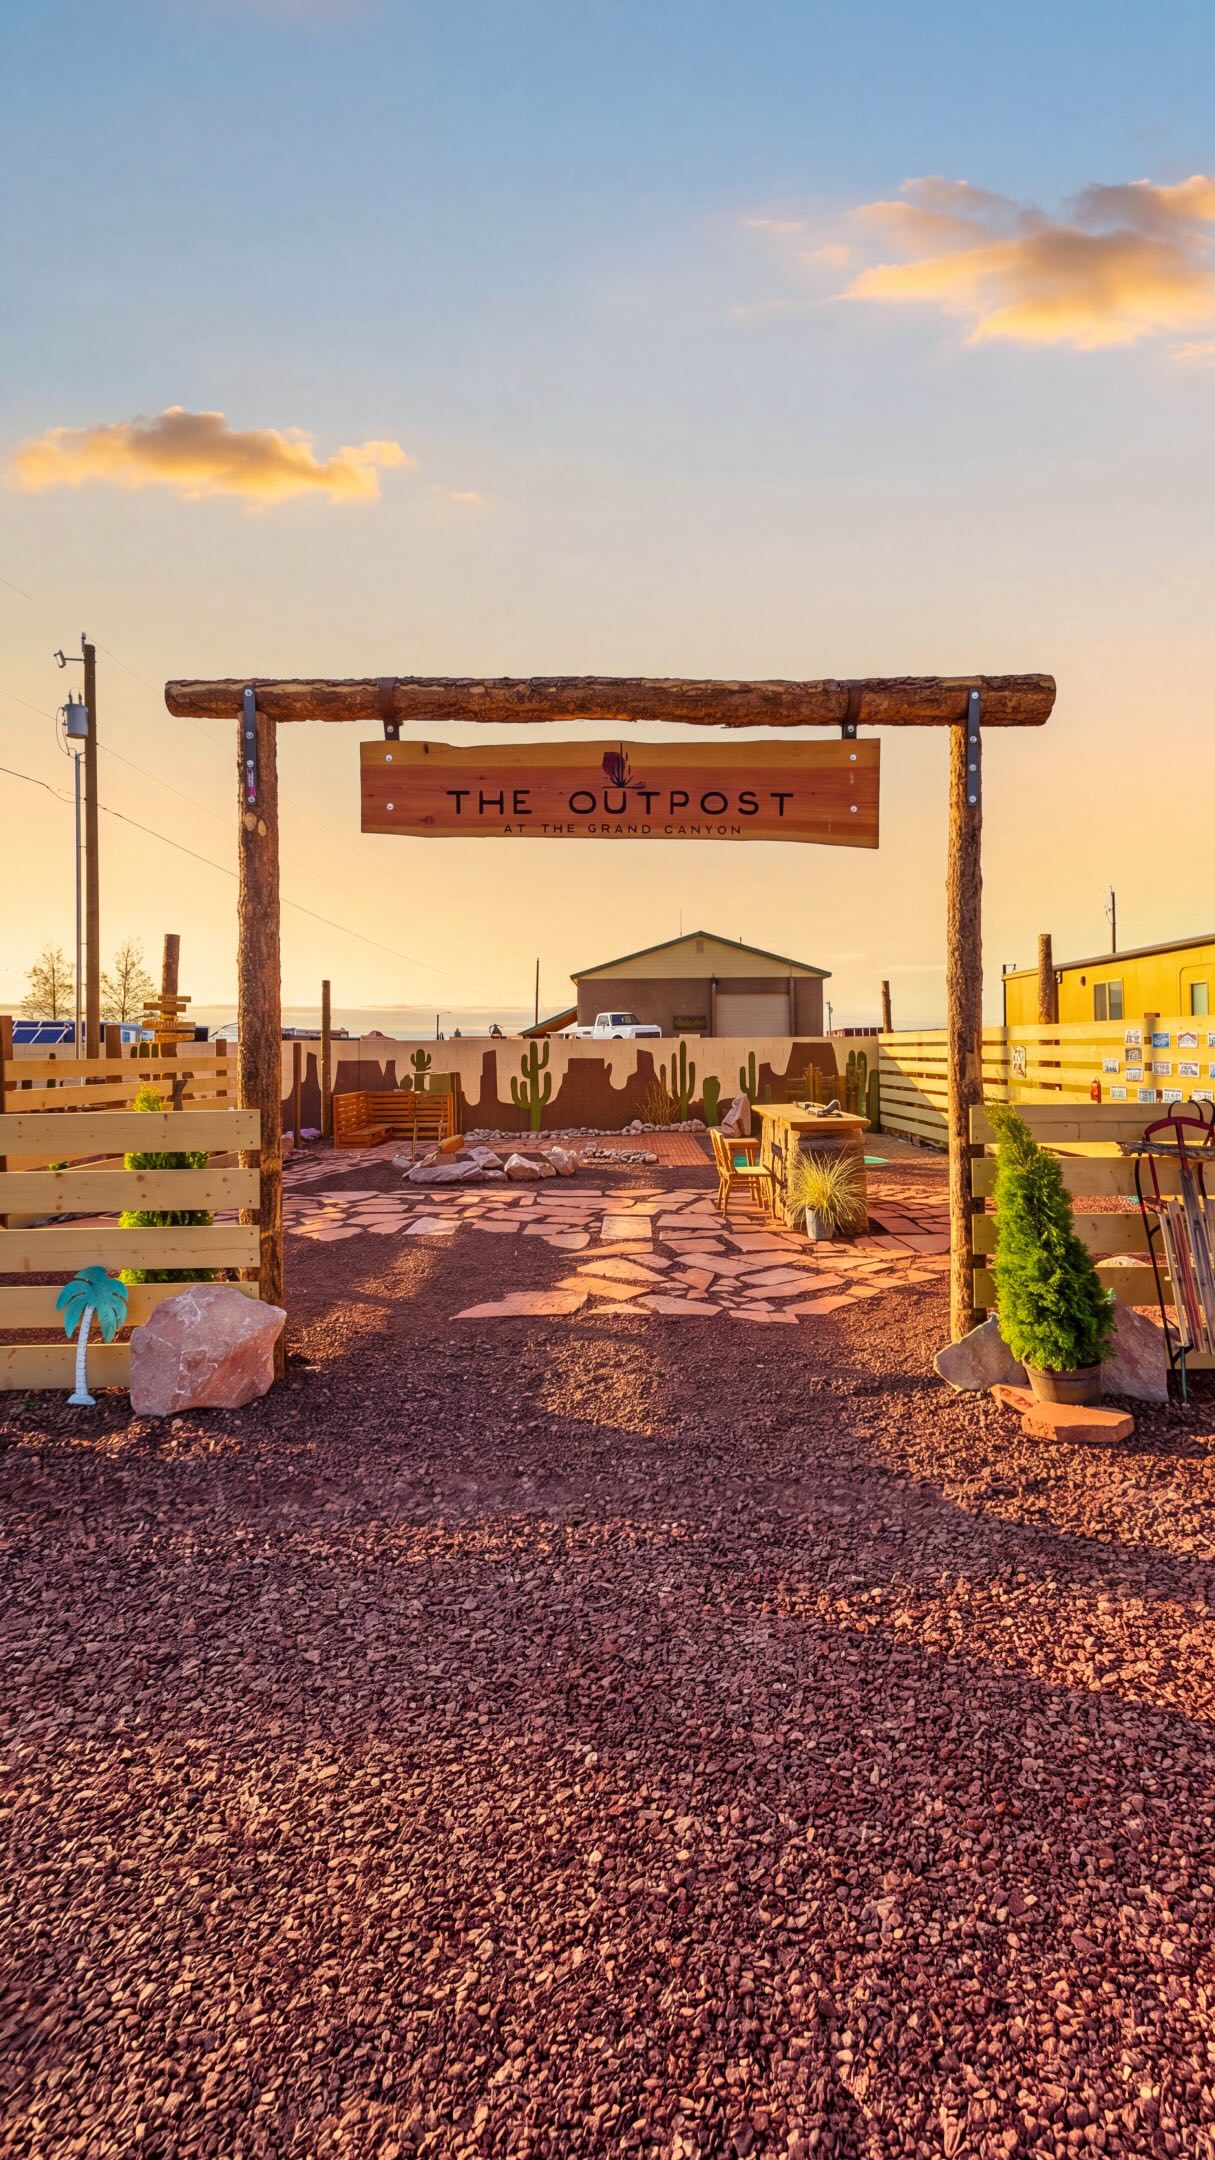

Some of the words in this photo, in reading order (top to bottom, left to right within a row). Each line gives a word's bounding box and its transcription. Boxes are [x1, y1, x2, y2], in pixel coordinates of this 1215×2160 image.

[446, 790, 532, 815] THE
[569, 790, 795, 816] OUTPOST
[504, 824, 525, 833] AT
[541, 824, 576, 833] THE
[588, 824, 652, 834] GRAND
[664, 825, 741, 835] CANYON
